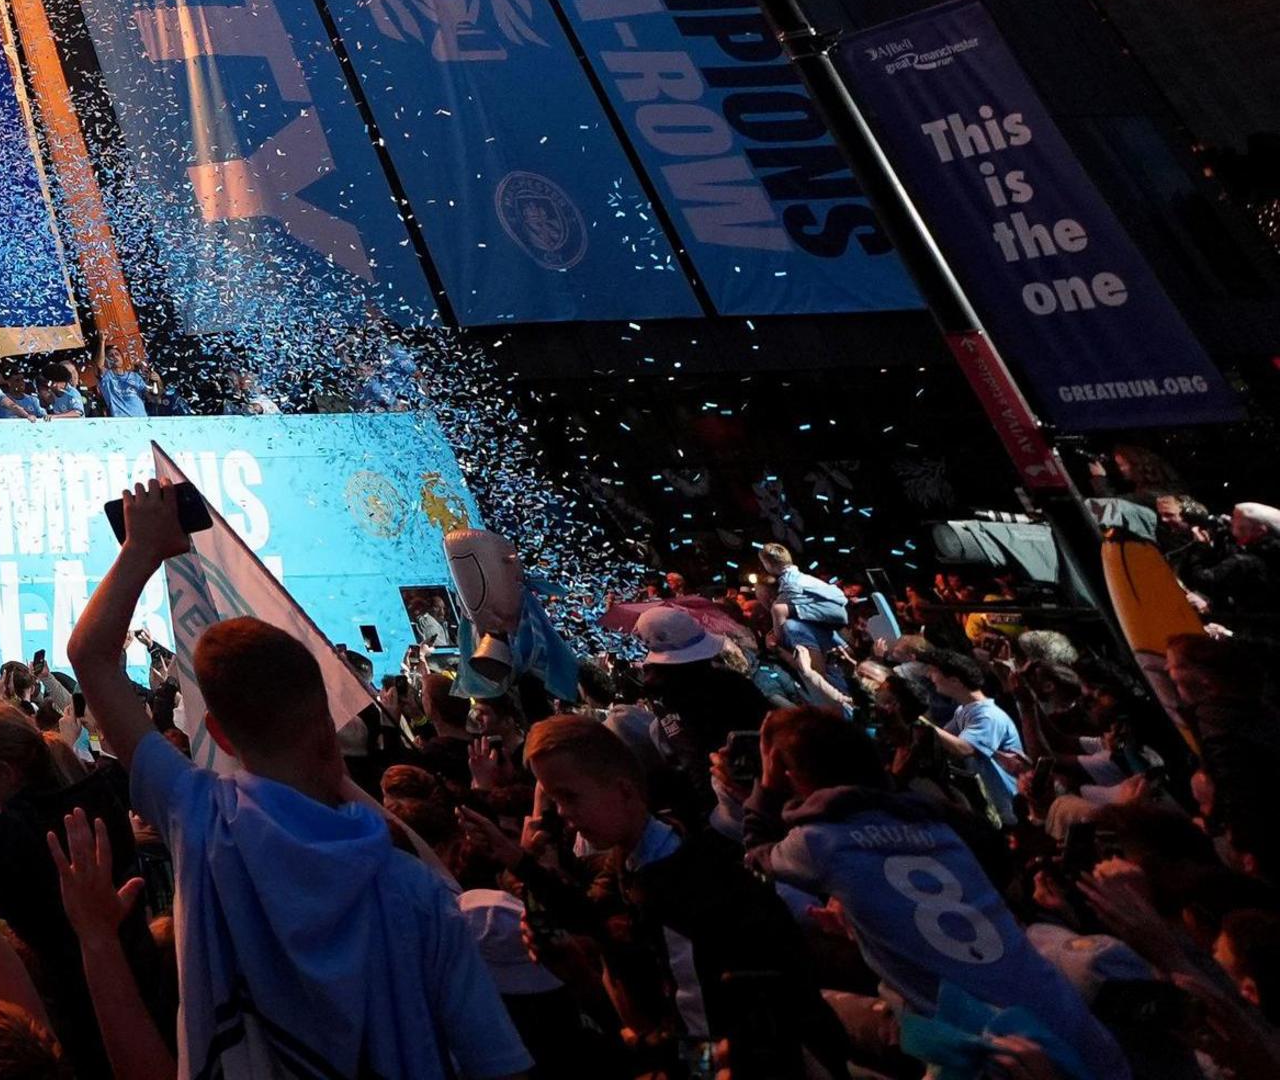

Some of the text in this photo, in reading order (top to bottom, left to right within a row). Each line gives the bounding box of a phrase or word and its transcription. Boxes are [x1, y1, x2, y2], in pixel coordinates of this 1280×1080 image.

[885, 58, 912, 75] great
[921, 105, 1033, 163] This
[978, 162, 1035, 208] is
[993, 212, 1089, 263] the
[1022, 271, 1129, 315] one
[1057, 375, 1209, 403] GREATRUN.ORG
[883, 855, 1005, 964] 8
